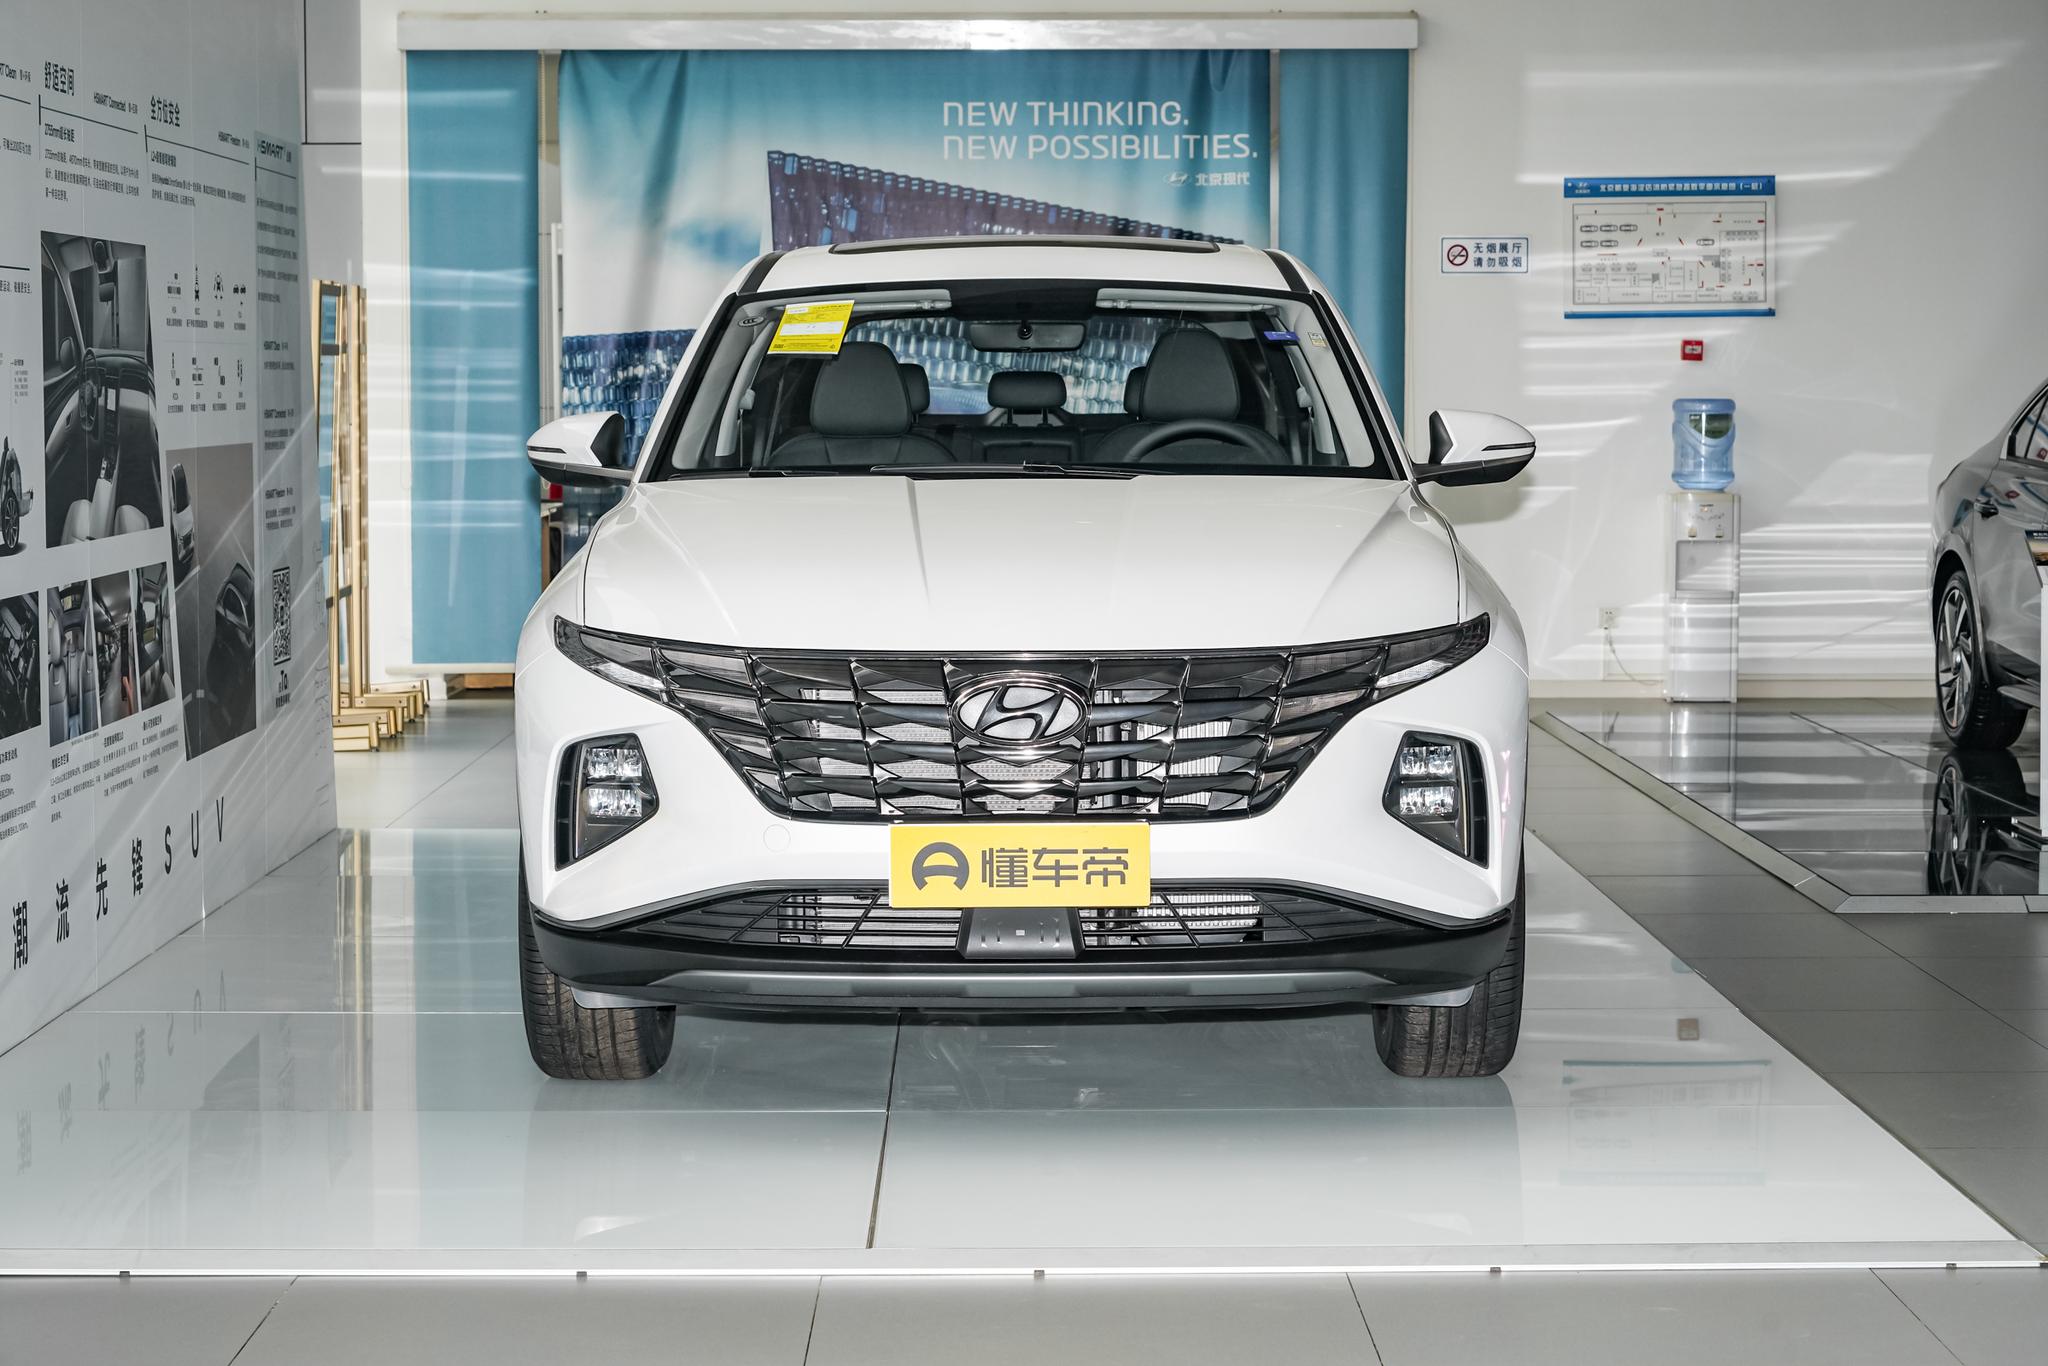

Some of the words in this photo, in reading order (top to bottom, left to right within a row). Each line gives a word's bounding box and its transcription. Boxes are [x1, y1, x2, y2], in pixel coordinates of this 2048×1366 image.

[44, 61, 75, 96] 舒适空间
[150, 96, 180, 127] 全方位安全
[943, 101, 1018, 127] NEW
[1027, 100, 1189, 127] THINKING.
[943, 134, 1018, 160] NEW
[1028, 133, 1258, 160] POSSIBILITIES.
[1195, 172, 1250, 186] 北京现代
[1473, 242, 1523, 255] 无烟展厅
[1473, 256, 1523, 268] 请勿吸烟
[981, 846, 1129, 888] 懂车帝
